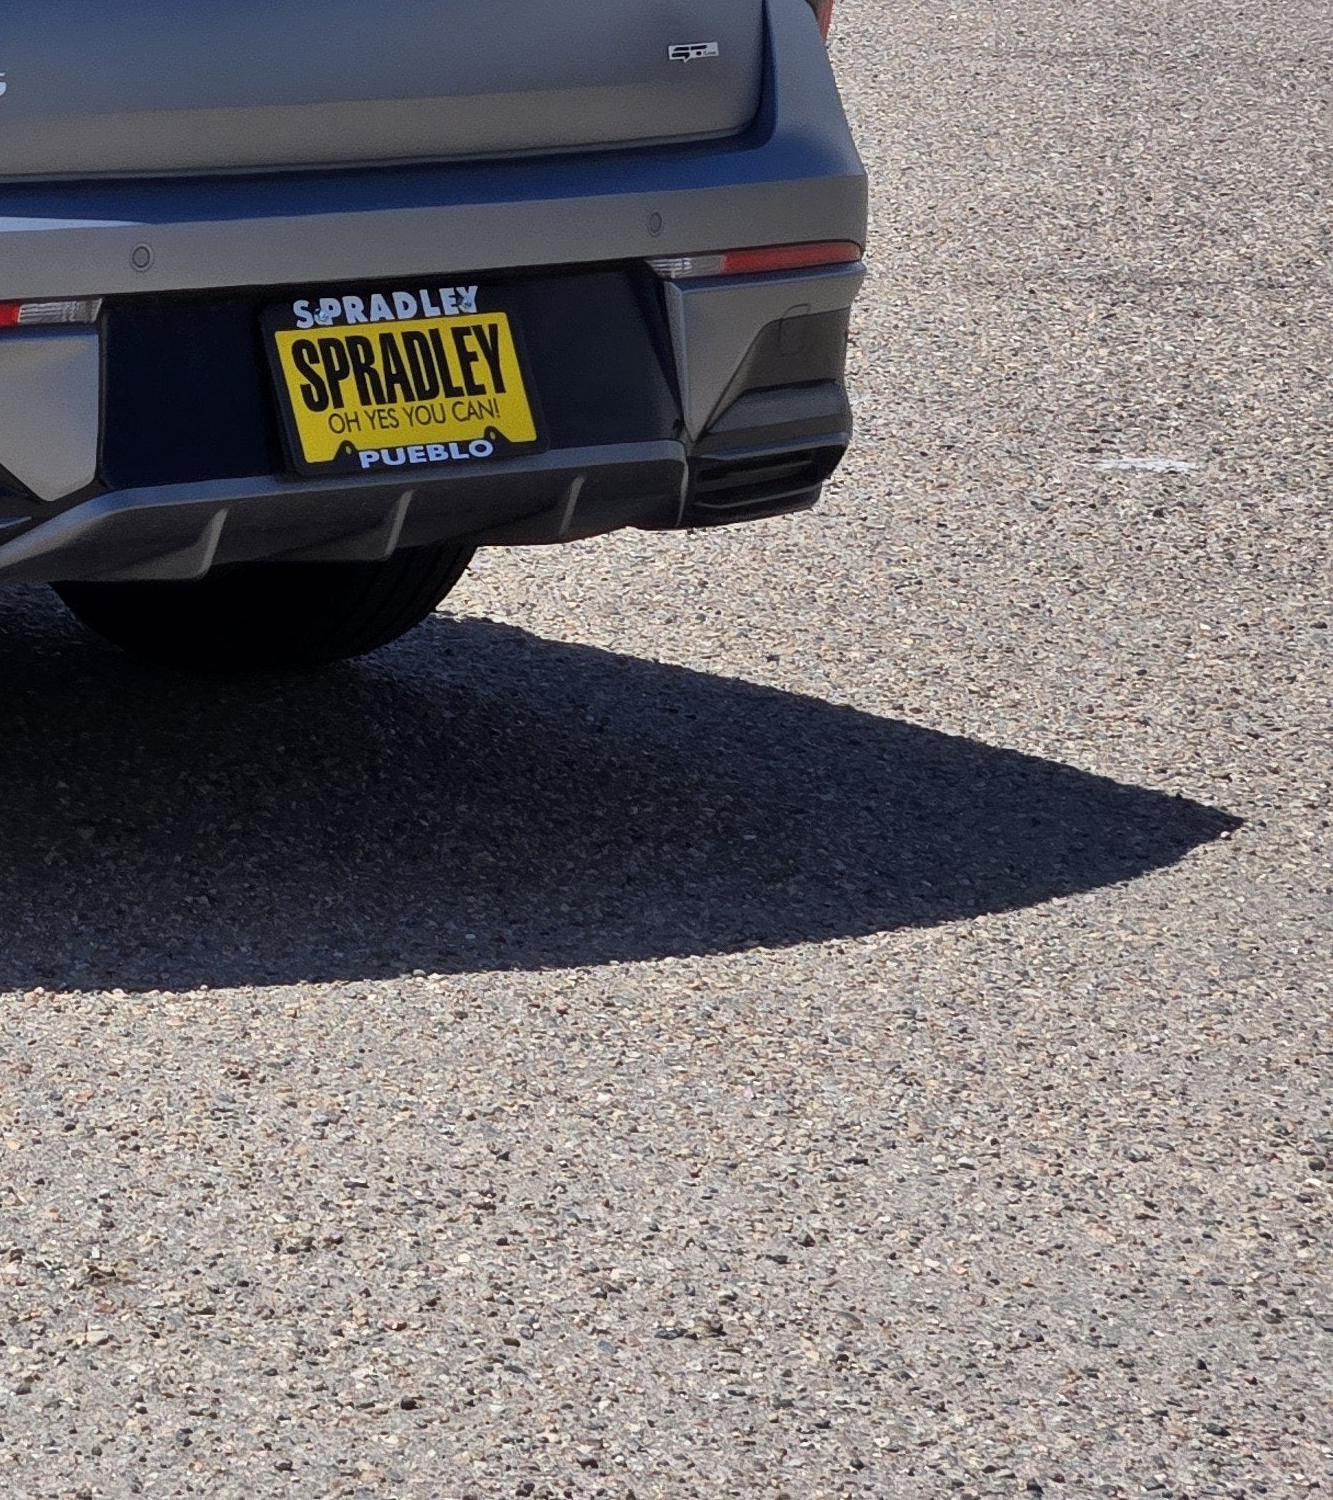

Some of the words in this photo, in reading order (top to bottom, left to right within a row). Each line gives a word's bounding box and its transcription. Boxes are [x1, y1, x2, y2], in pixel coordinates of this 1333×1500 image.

[292, 285, 479, 329] SPRADLEY
[290, 323, 507, 413] SPRADLEY
[328, 411, 362, 435] OH
[366, 408, 400, 430] YES
[402, 402, 446, 427] YOU
[451, 398, 500, 423] CAN!
[358, 438, 495, 470] PUEBLO
